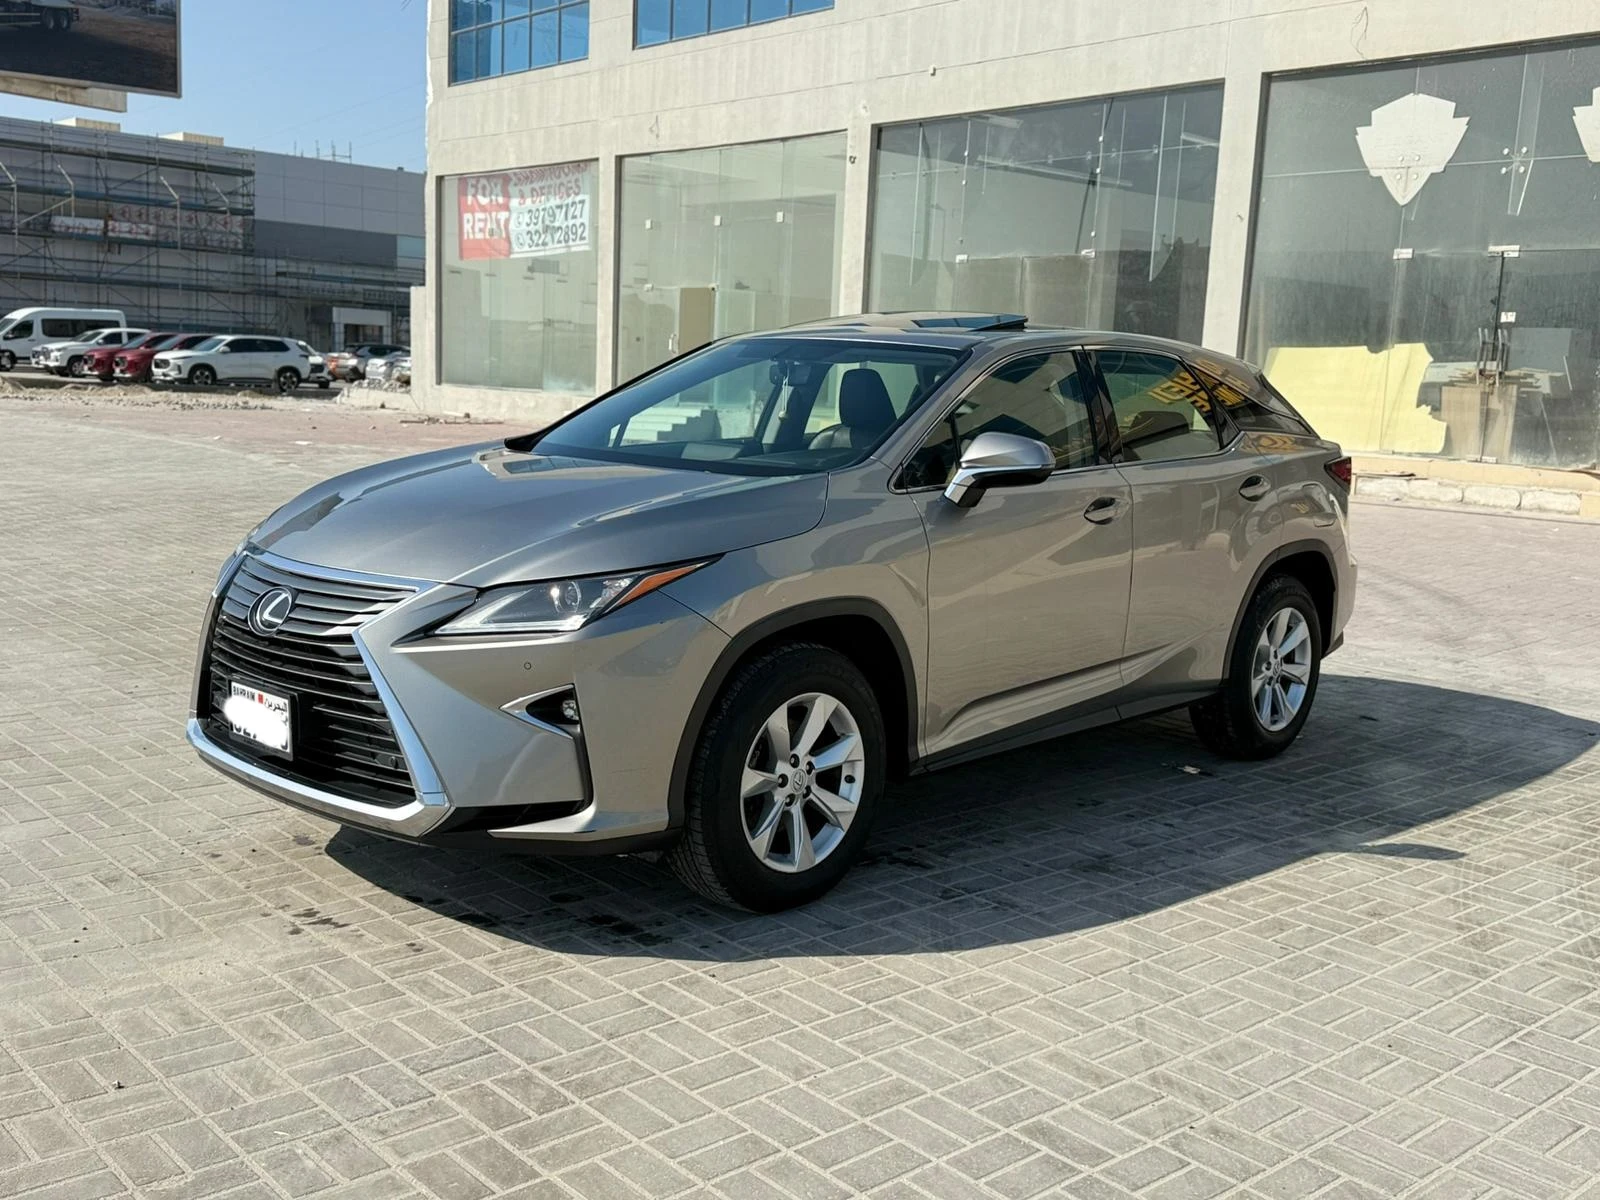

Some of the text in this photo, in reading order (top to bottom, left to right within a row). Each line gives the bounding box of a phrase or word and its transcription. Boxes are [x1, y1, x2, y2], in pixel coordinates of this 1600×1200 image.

[530, 177, 582, 205] OFFICES
[463, 211, 510, 241] RENT
[526, 199, 586, 228] 39797127
